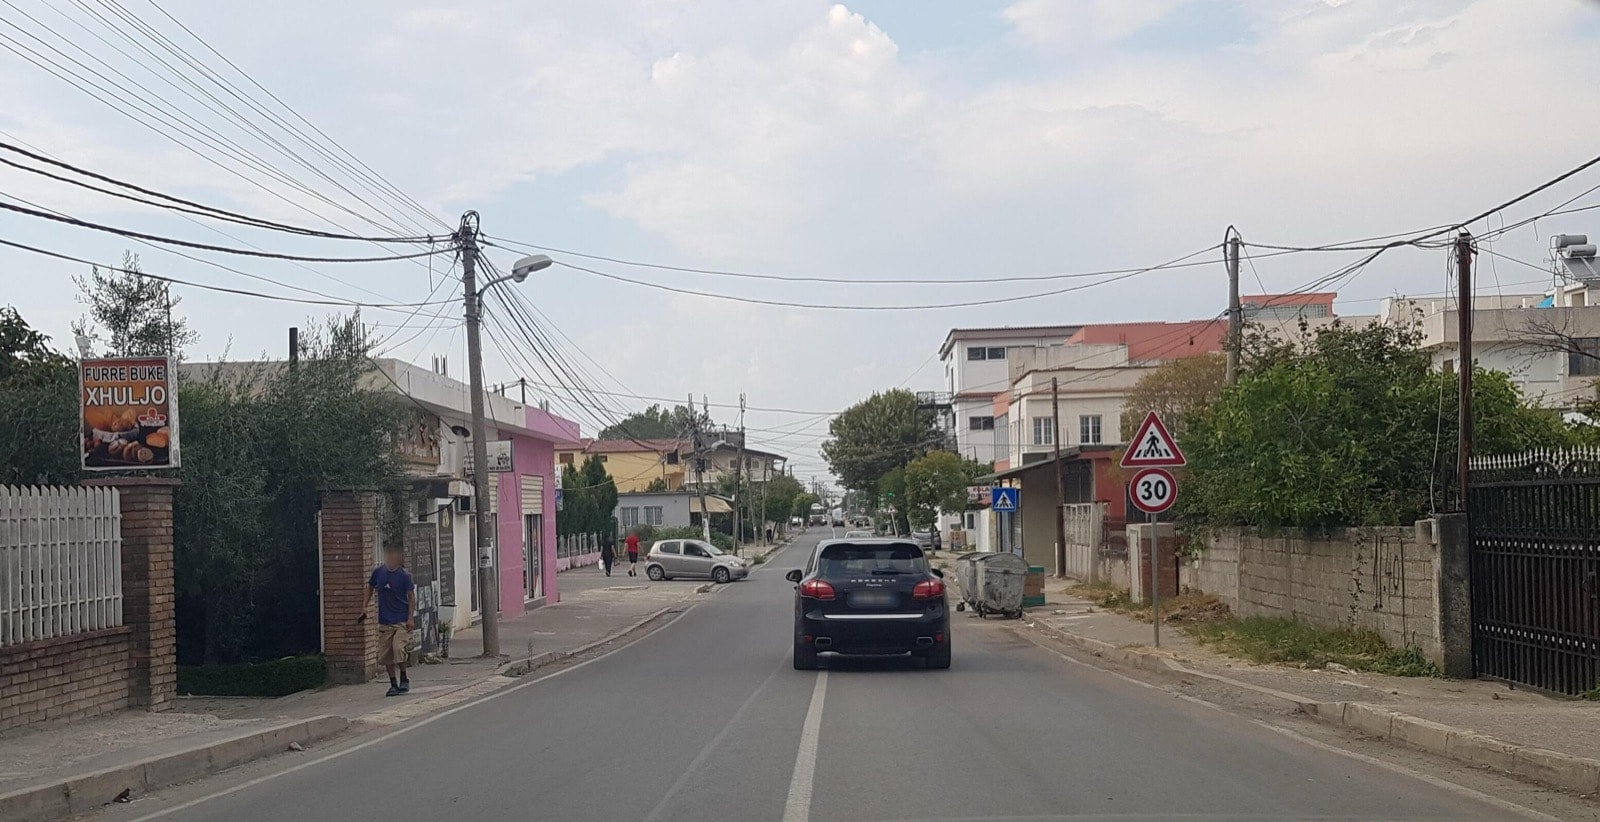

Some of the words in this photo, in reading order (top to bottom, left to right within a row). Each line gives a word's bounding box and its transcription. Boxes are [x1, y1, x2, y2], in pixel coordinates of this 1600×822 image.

[85, 367, 126, 381] FURRE
[130, 367, 165, 381] BUKE
[86, 386, 166, 406] XHULJO
[1141, 480, 1167, 501] 30
